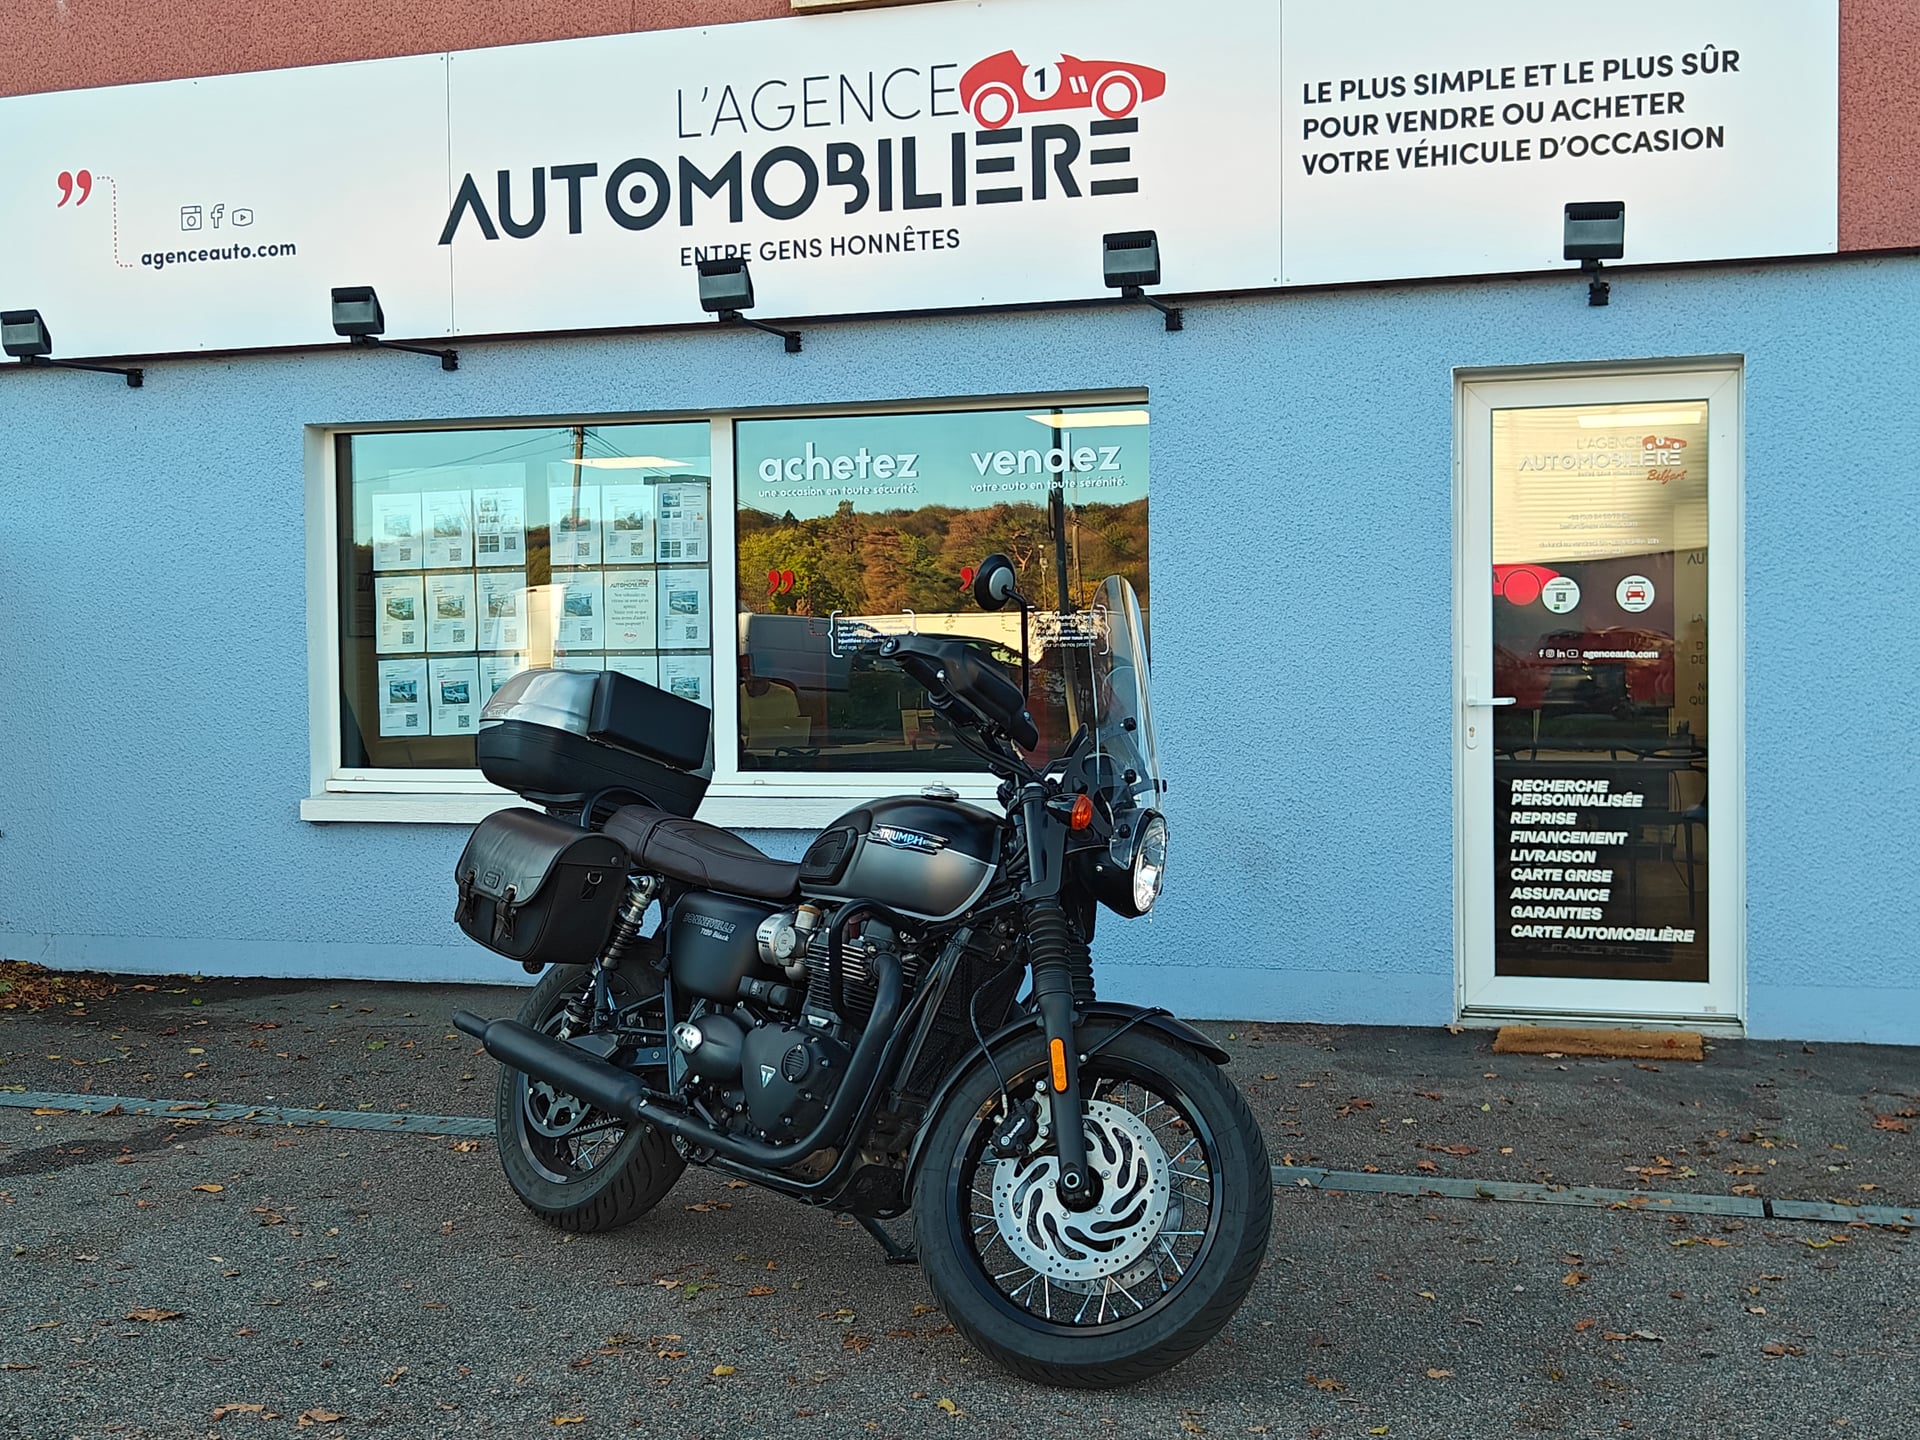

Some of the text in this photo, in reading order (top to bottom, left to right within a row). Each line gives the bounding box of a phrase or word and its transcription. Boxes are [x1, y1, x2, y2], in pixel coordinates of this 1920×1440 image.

[1033, 67, 1048, 92] 1
[1303, 43, 1740, 104] LE PLUS SIMPLE ET LE PLUS SÛR
[1303, 91, 1685, 140] POUR VENDRE OU ACHETER
[1302, 148, 1389, 175] VOTRE
[1397, 138, 1531, 170] VÉHICULE
[438, 117, 1139, 245] AUTOMOBILIERE
[680, 225, 960, 266] ENTRE GENS HONNÊTES
[141, 239, 297, 270] agenceauto.com
[759, 442, 919, 482] achetez
[971, 432, 1121, 475] vendez
[781, 486, 823, 496] occasion
[843, 486, 870, 495] toute
[971, 482, 998, 492] votre
[1001, 482, 1027, 491] auto
[1030, 482, 1044, 490] en
[1047, 480, 1076, 489] toute
[1582, 649, 1659, 660] agenceauto.com
[1511, 779, 1609, 793] RECHERCHE
[1511, 792, 1644, 808] PERSONNALISÉE
[1510, 812, 1578, 825] REPRISE
[879, 827, 924, 846] TRIUMPH
[1510, 831, 1629, 845] FINANCEMENT
[1510, 849, 1597, 863] LIVRAISON
[1511, 868, 1613, 883] CARTE GRISE
[1510, 887, 1611, 901] ASSURANCE
[1511, 906, 1603, 920] GARANTIES
[1511, 925, 1695, 943] CARTE AUTOMOBILIÈRE
